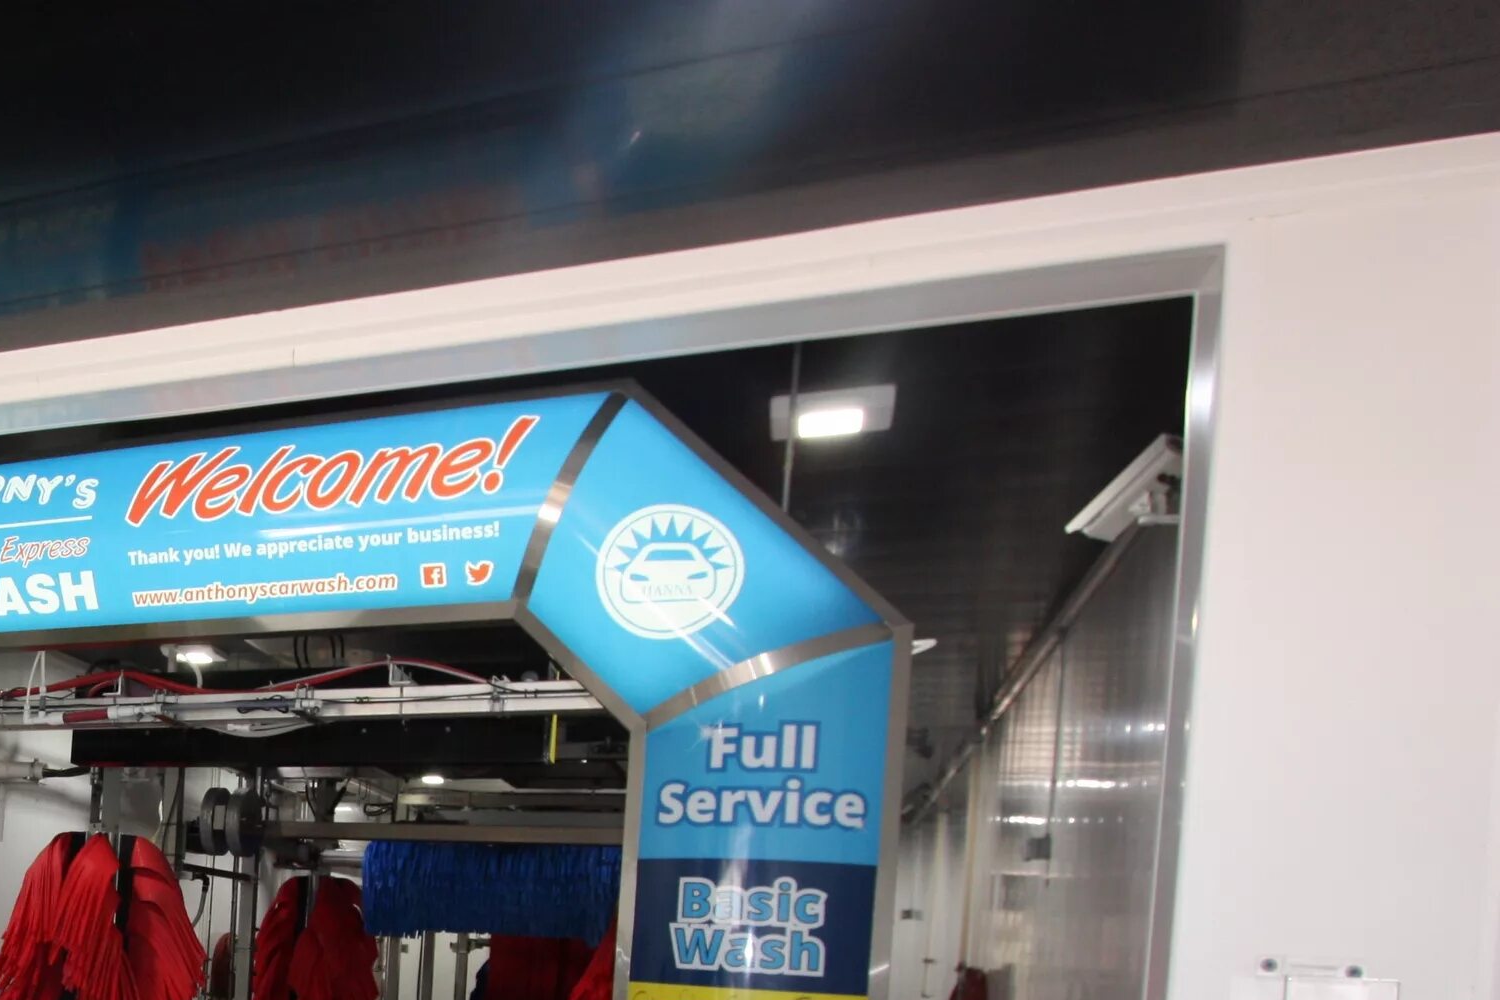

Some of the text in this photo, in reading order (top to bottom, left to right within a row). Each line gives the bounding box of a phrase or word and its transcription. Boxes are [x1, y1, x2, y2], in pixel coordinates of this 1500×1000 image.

[125, 415, 540, 527] Welcome!
[0, 535, 91, 568] Express
[128, 521, 501, 567] Thank you! We appreciate your business!
[132, 573, 397, 607] www.anthonyscarwash.com
[706, 720, 821, 773] Full
[655, 776, 868, 830] Service
[677, 876, 828, 930] Basic
[669, 922, 826, 977] Wash
